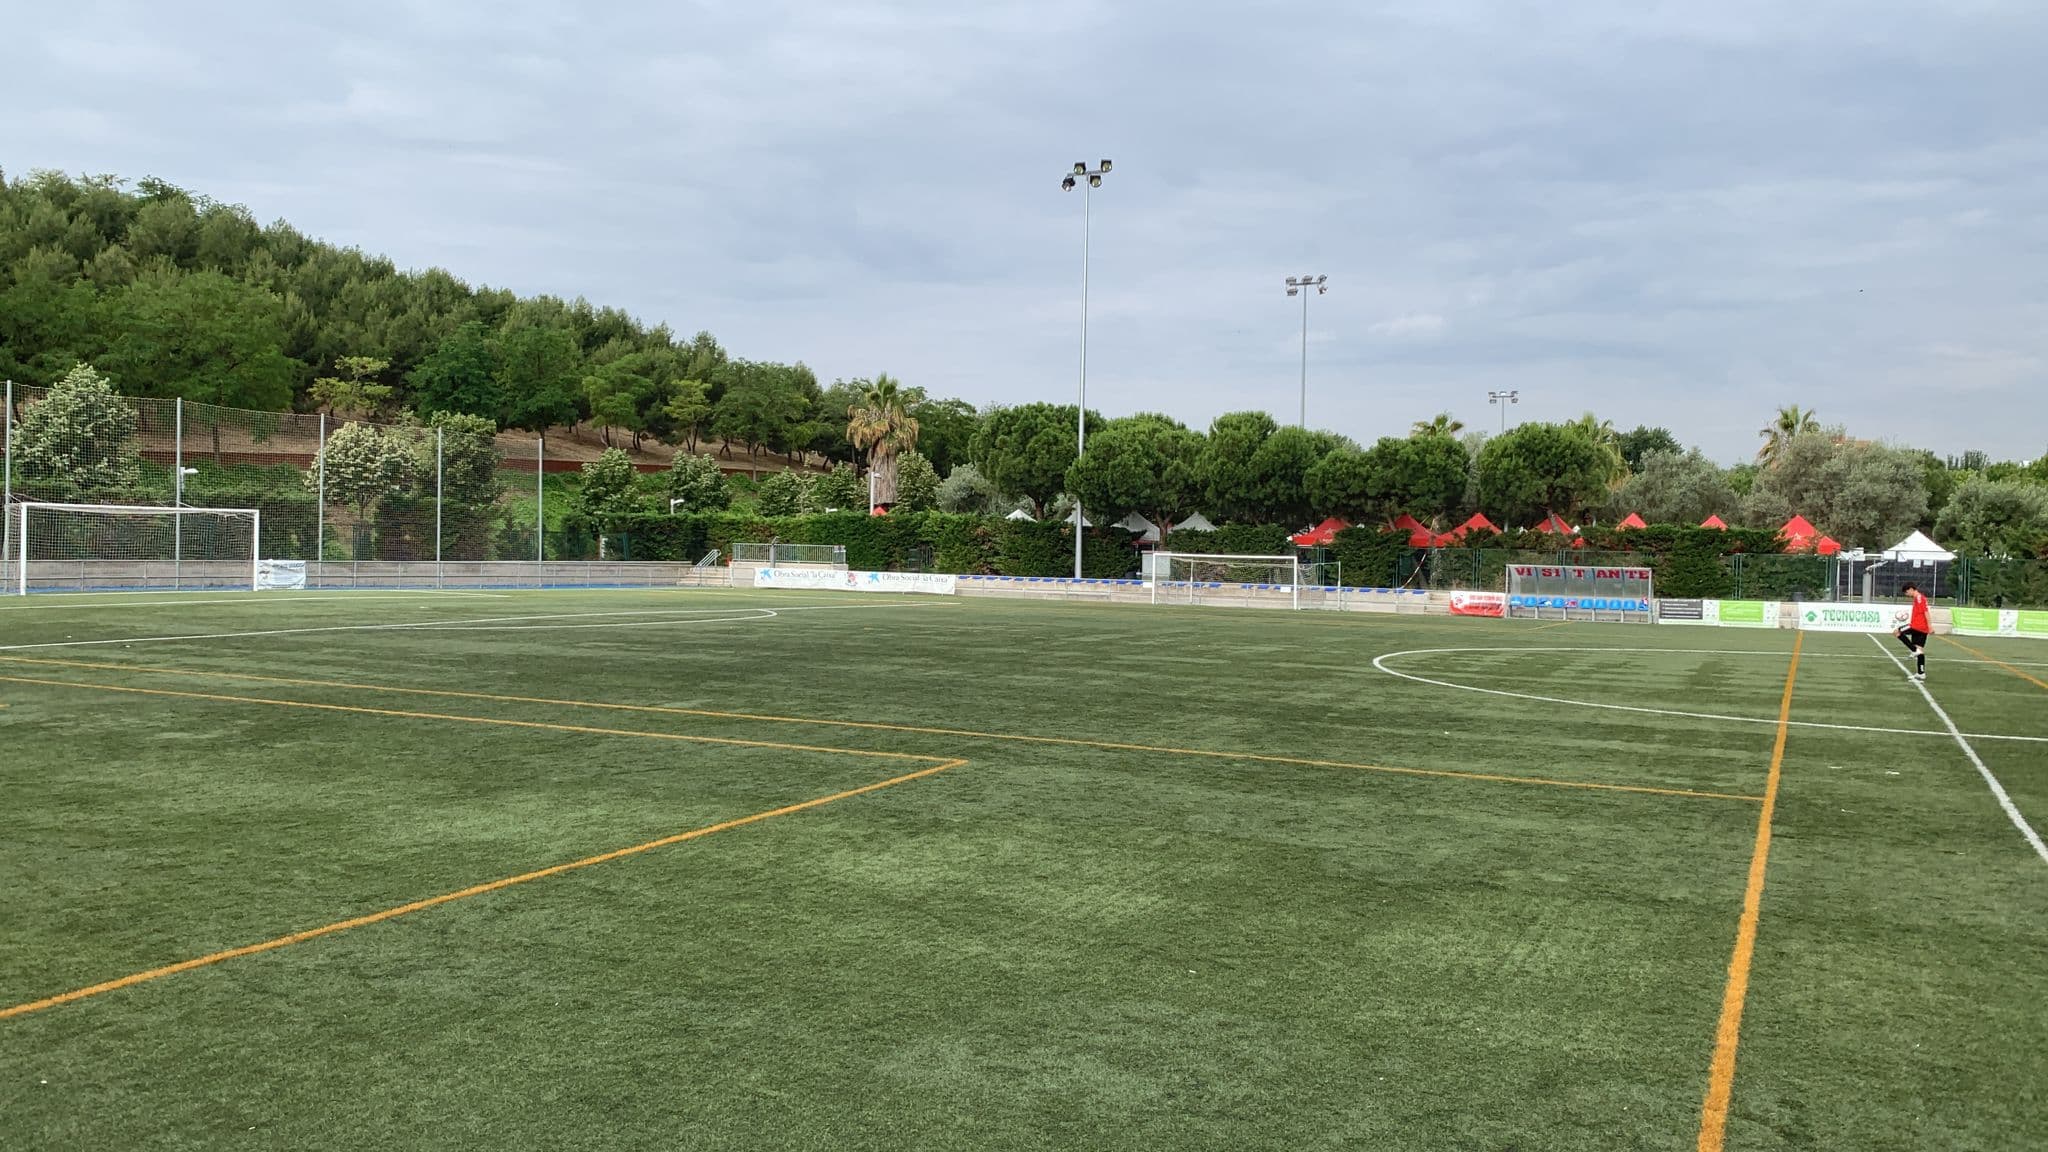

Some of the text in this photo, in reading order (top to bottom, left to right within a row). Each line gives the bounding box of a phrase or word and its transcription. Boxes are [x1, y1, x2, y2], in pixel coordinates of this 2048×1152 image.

[773, 570, 789, 578] Obra
[790, 570, 809, 578] Social
[882, 574, 899, 582] Obra
[900, 574, 920, 582] Social
[1822, 609, 1881, 623] TECNOCASA
